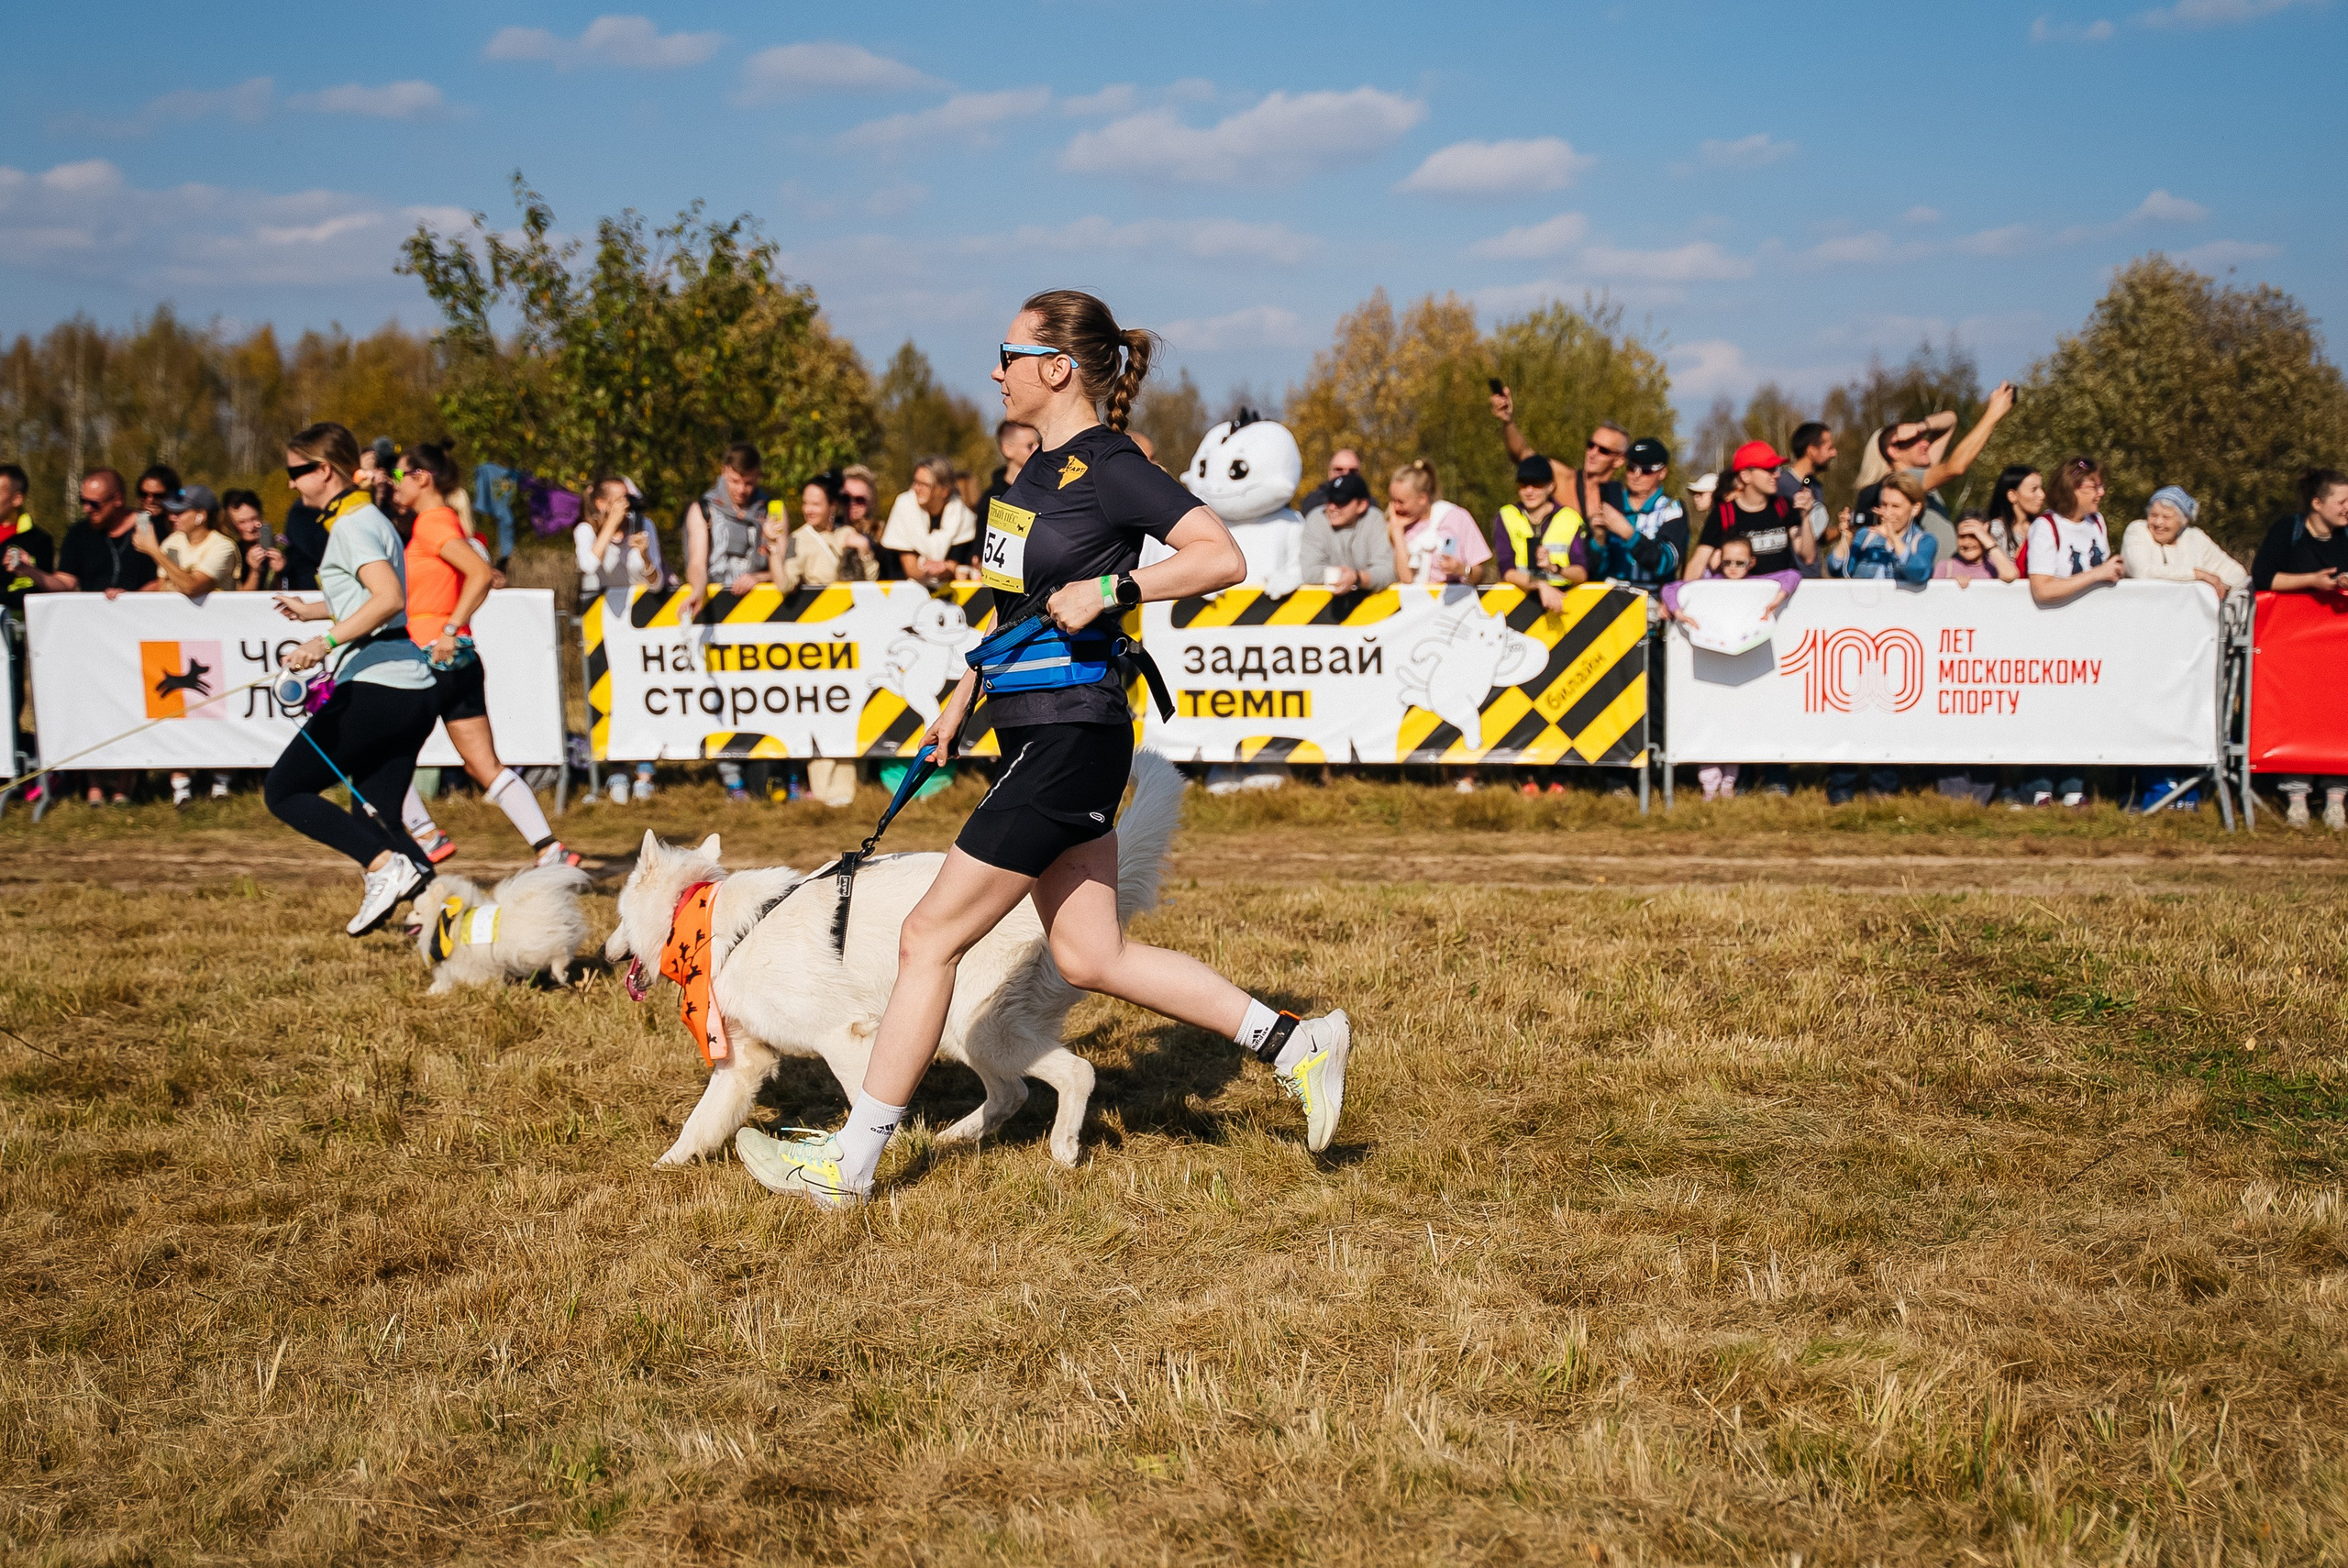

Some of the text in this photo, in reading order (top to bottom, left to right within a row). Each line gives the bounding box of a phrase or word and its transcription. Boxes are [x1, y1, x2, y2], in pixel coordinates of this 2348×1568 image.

[991, 506, 1004, 520] ТРЫЙ
[1002, 512, 1019, 525] ПЁС
[984, 532, 1008, 569] 54
[641, 632, 853, 672] на твоей
[1939, 629, 1977, 653] ЛЕТ
[1183, 636, 1382, 681] задавай
[1780, 628, 1923, 713] 100
[1938, 659, 2102, 684] МОСКОВСКОМУ
[644, 685, 851, 726] стороне
[1184, 690, 1305, 718] темп
[1938, 690, 2020, 714] СПОРТУ
